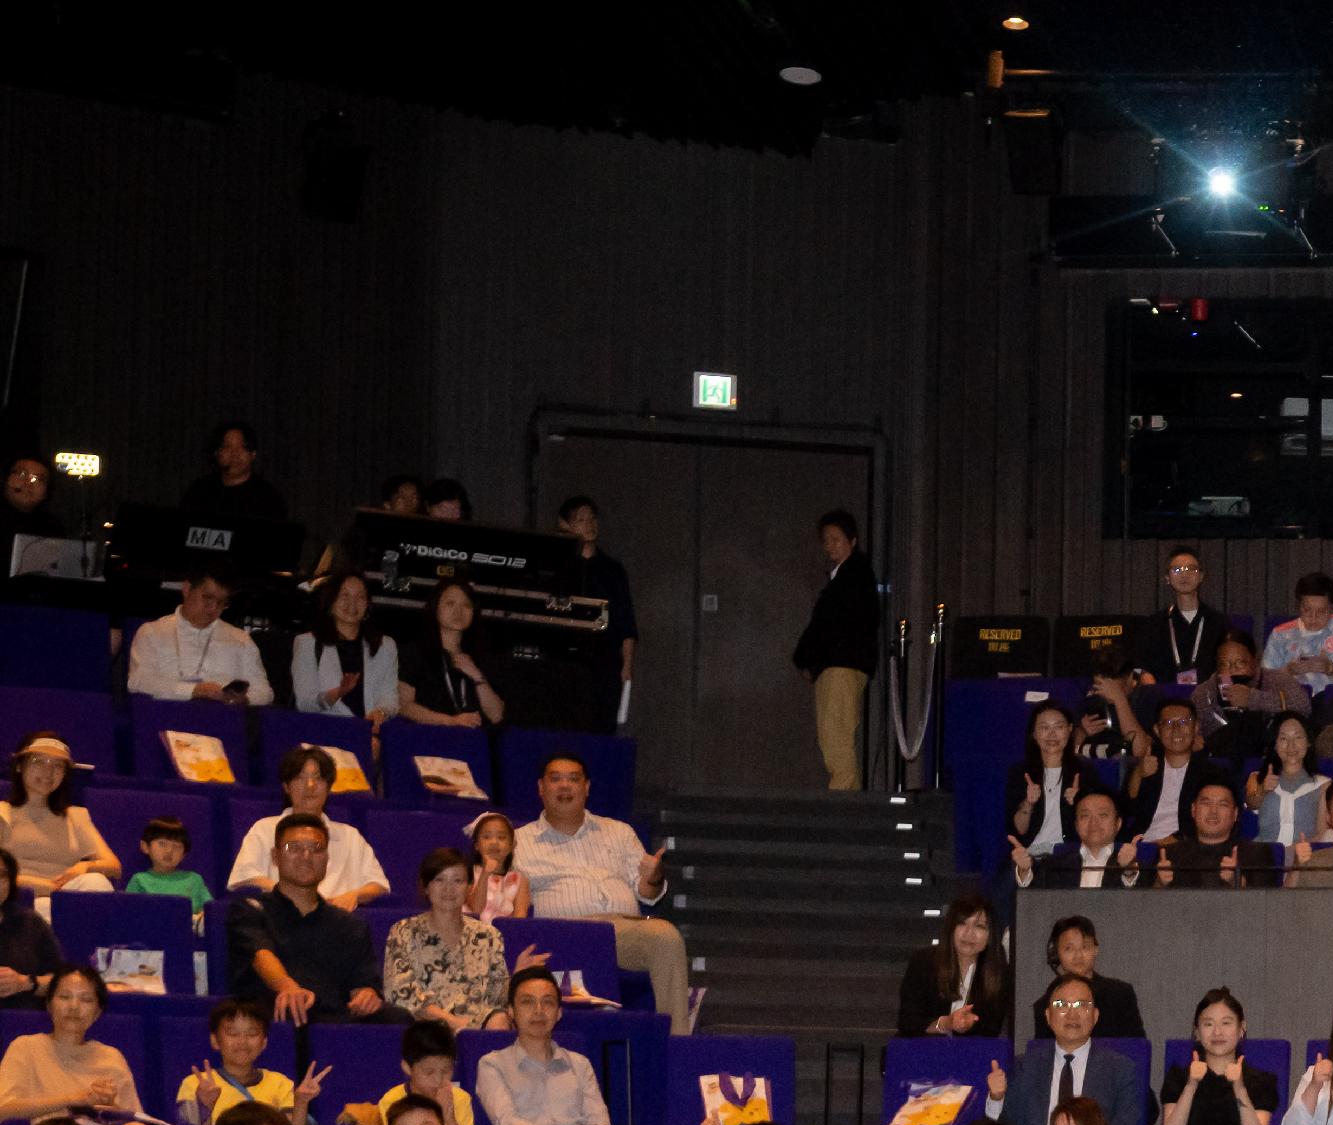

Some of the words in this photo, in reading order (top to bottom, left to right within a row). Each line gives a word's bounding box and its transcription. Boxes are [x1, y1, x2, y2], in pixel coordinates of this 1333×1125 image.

[416, 544, 469, 561] DiGiCo
[979, 629, 1022, 640] RESERVED
[1080, 624, 1123, 637] RESERVED
